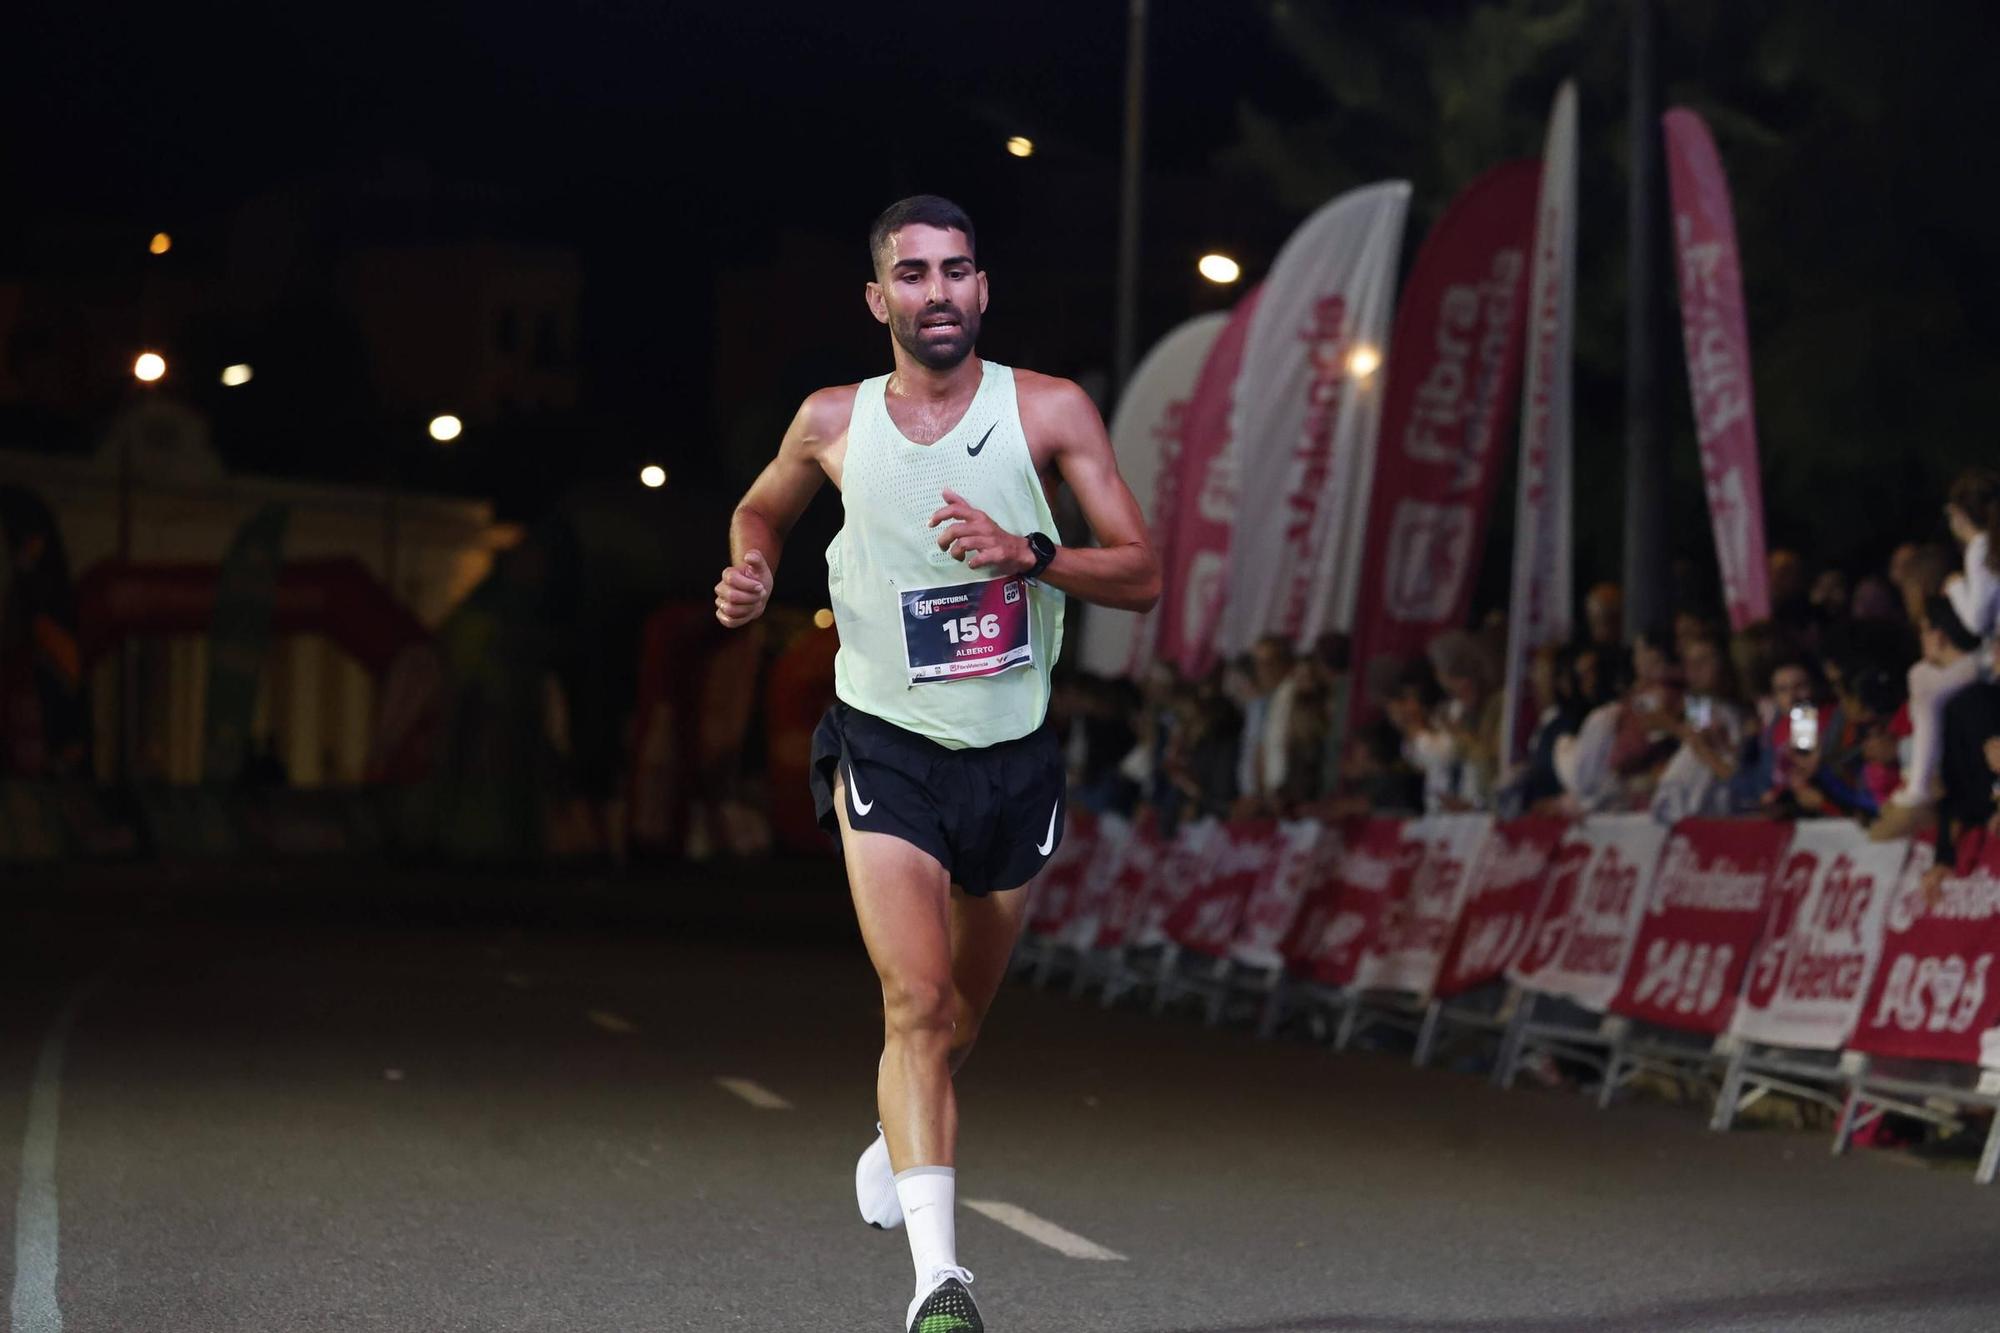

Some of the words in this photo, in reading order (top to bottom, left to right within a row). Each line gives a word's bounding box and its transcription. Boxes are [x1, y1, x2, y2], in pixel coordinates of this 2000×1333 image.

[1403, 282, 1480, 464] Fibra
[914, 599, 933, 616] 15K
[932, 594, 969, 606] NOCTURNA
[942, 613, 1000, 644] 156
[956, 645, 994, 657] ALBERTO
